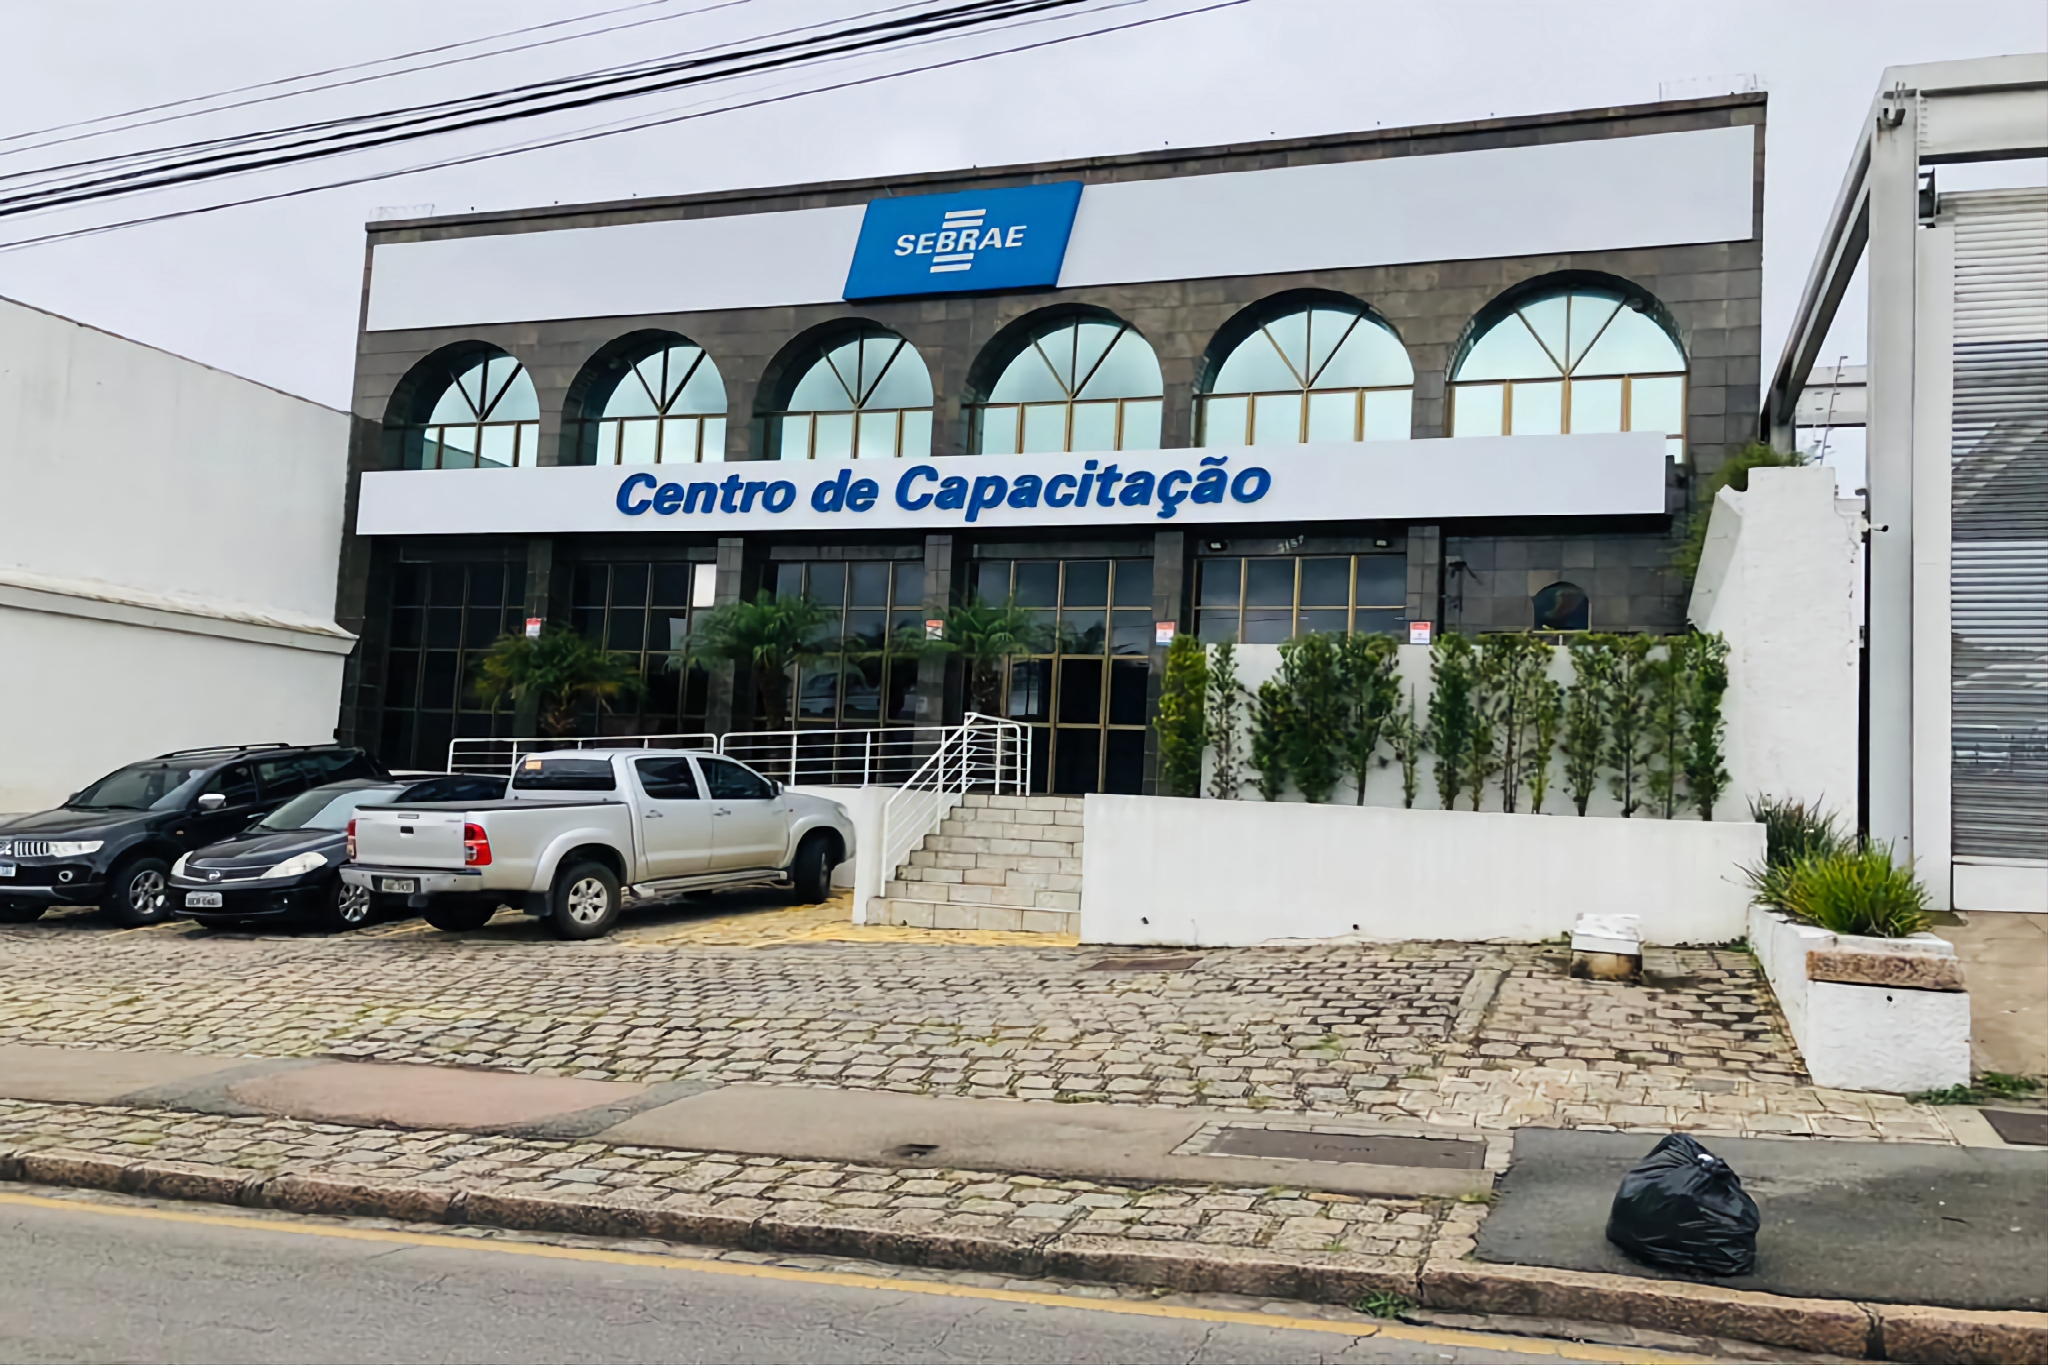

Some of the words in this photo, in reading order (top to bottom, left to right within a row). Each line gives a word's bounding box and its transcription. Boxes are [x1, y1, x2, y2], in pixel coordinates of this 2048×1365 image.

[894, 225, 1027, 257] SEBRAE
[617, 472, 797, 517] Centro
[811, 468, 880, 513] de
[895, 455, 1273, 523] Capacitação
